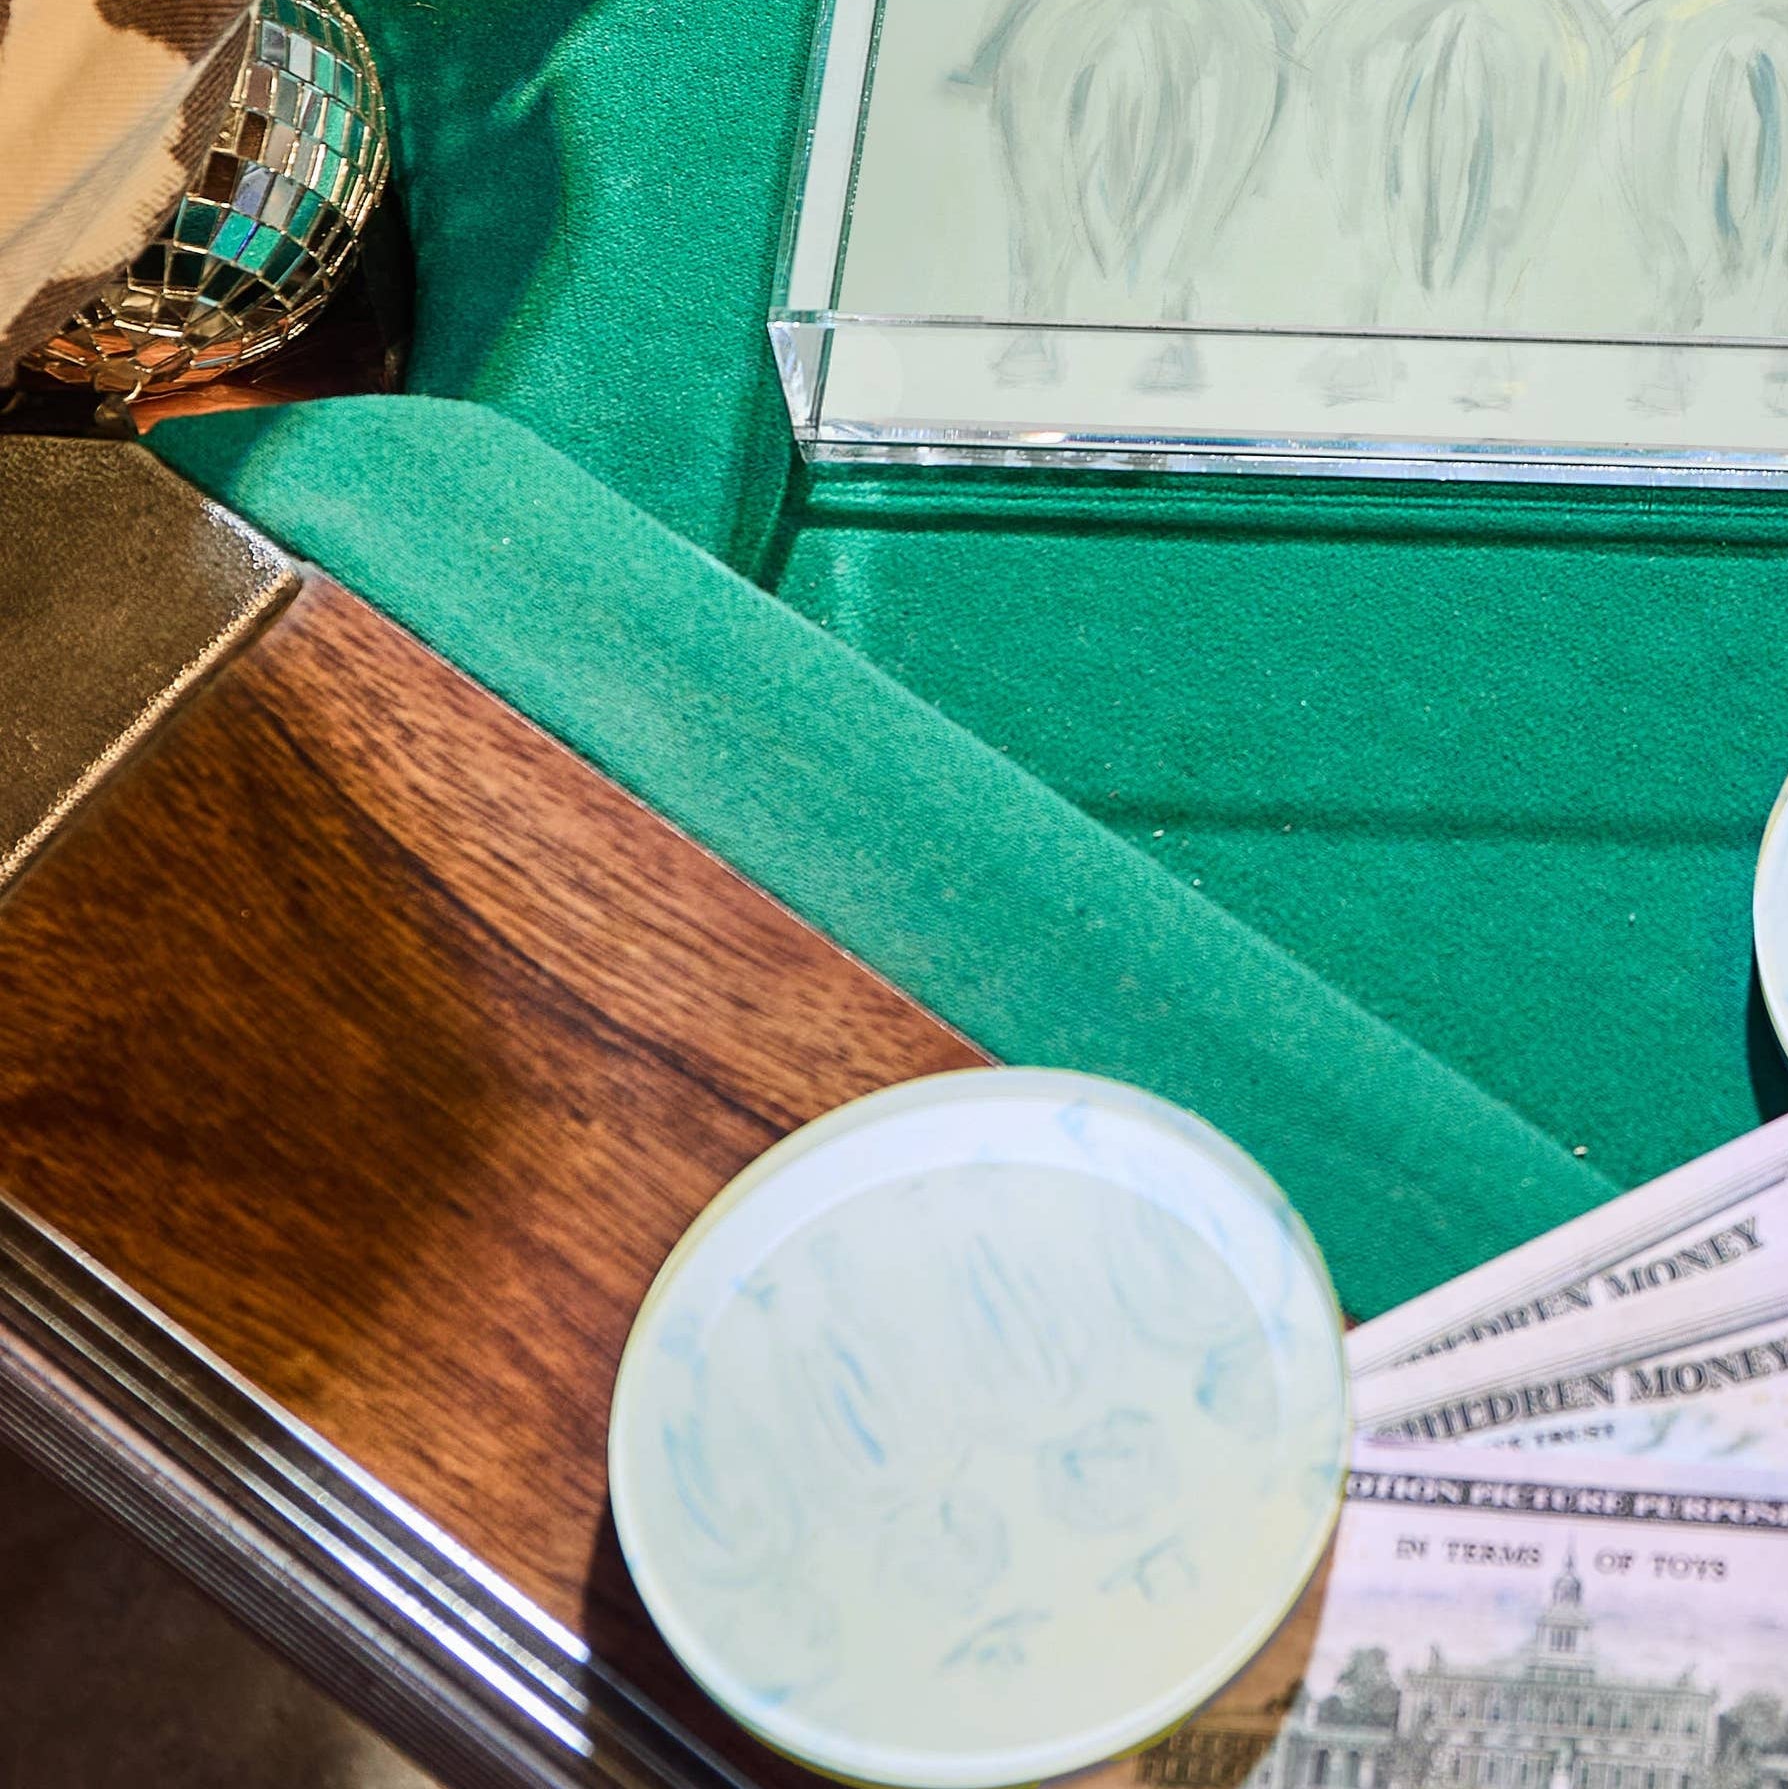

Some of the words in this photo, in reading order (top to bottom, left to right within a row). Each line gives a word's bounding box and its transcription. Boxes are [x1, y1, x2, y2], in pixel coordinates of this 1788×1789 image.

[1606, 1215, 1765, 1299] MONEY
[1348, 1473, 1461, 1506] OTION
[1470, 1485, 1624, 1517] PICTURE
[1396, 1537, 1430, 1561] IN
[1446, 1541, 1543, 1567] TERMS
[1594, 1550, 1635, 1575] OF
[1653, 1554, 1728, 1582] TOYS
